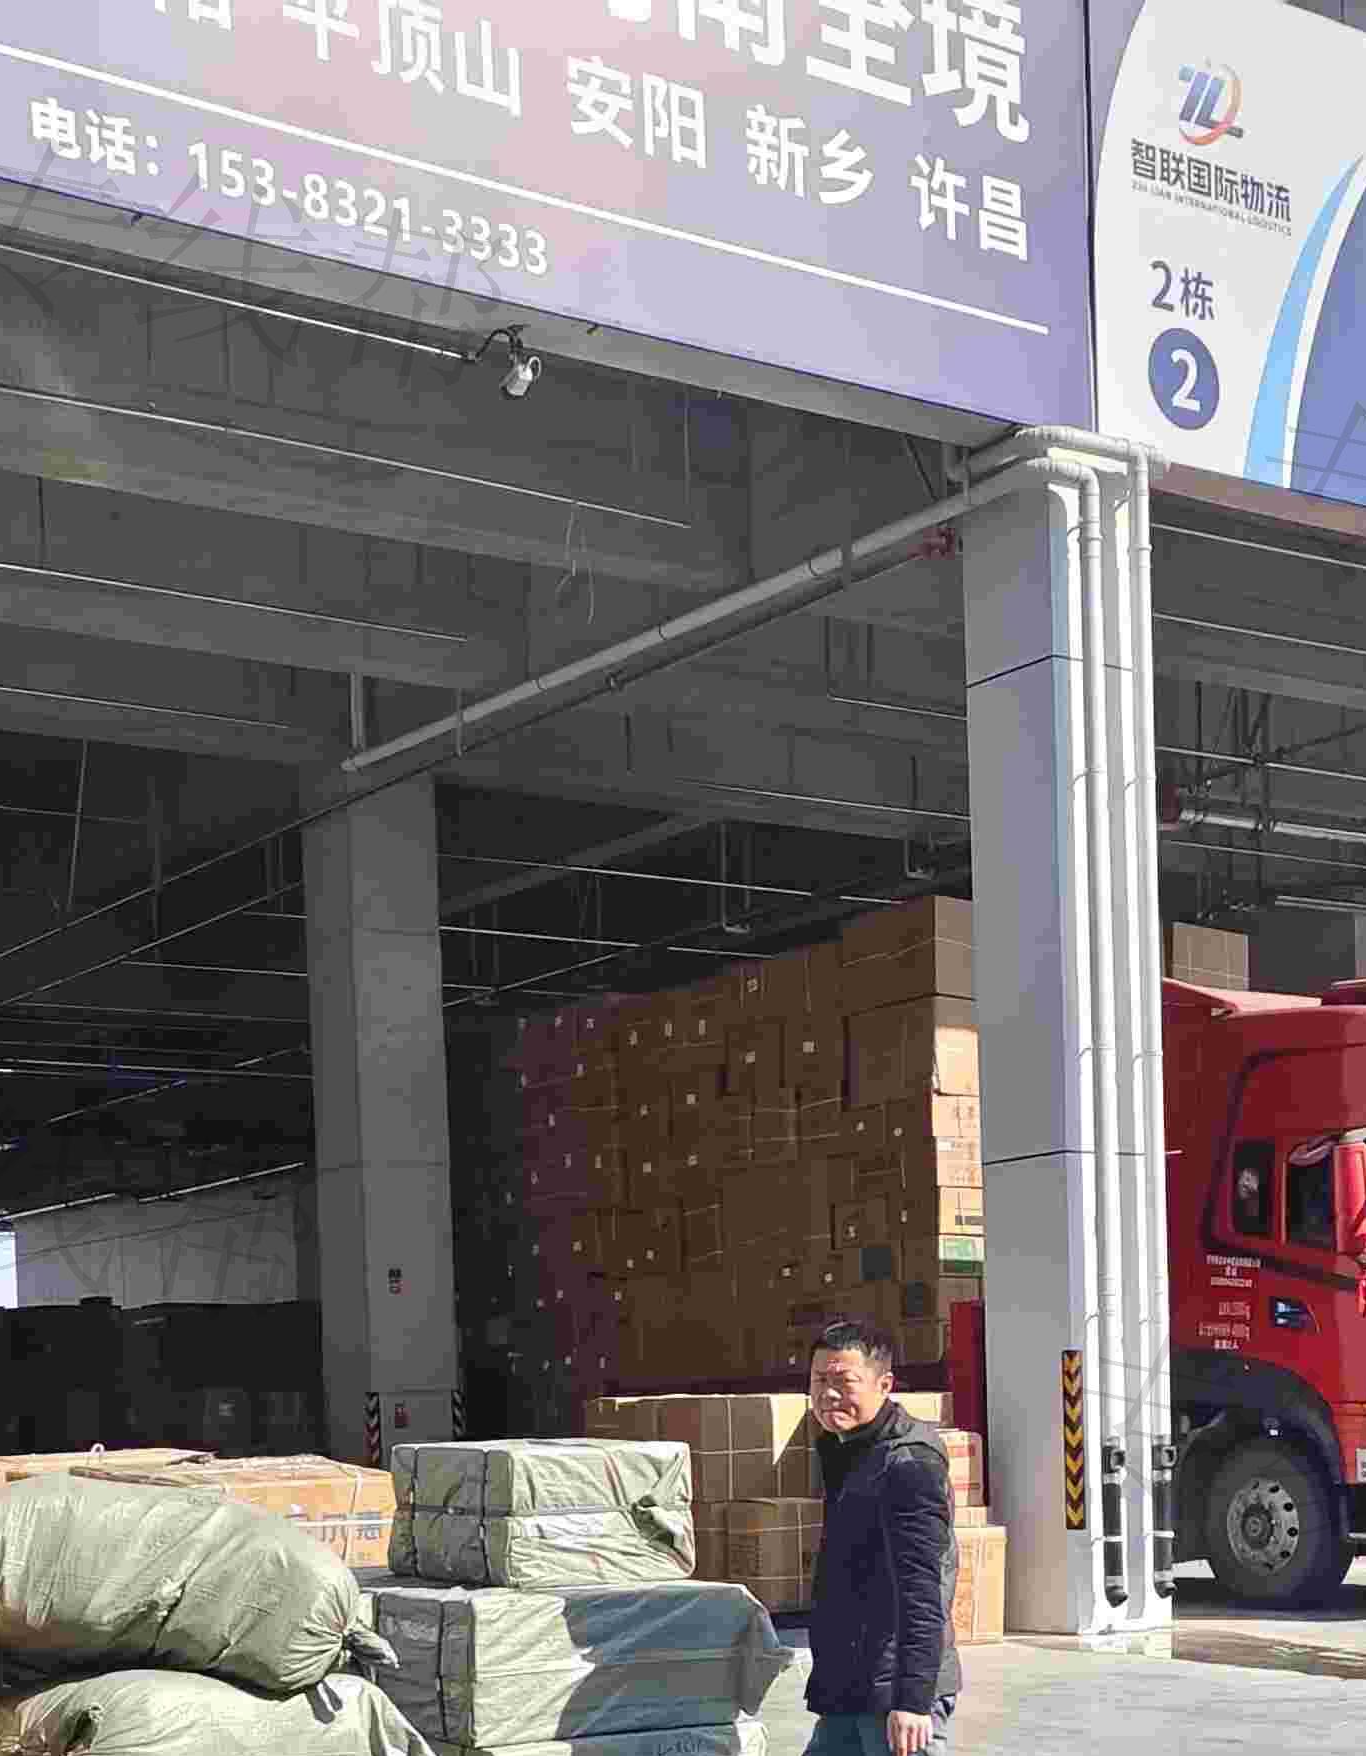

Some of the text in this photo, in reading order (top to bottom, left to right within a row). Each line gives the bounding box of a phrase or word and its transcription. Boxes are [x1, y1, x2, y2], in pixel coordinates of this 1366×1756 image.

[565, 55, 707, 168] 安阳
[745, 104, 874, 204] 新乡
[911, 153, 1027, 261] 许昌
[1131, 138, 1292, 222] 智联国际物流
[1150, 260, 1215, 321] 2栋
[1170, 349, 1202, 413] 2
